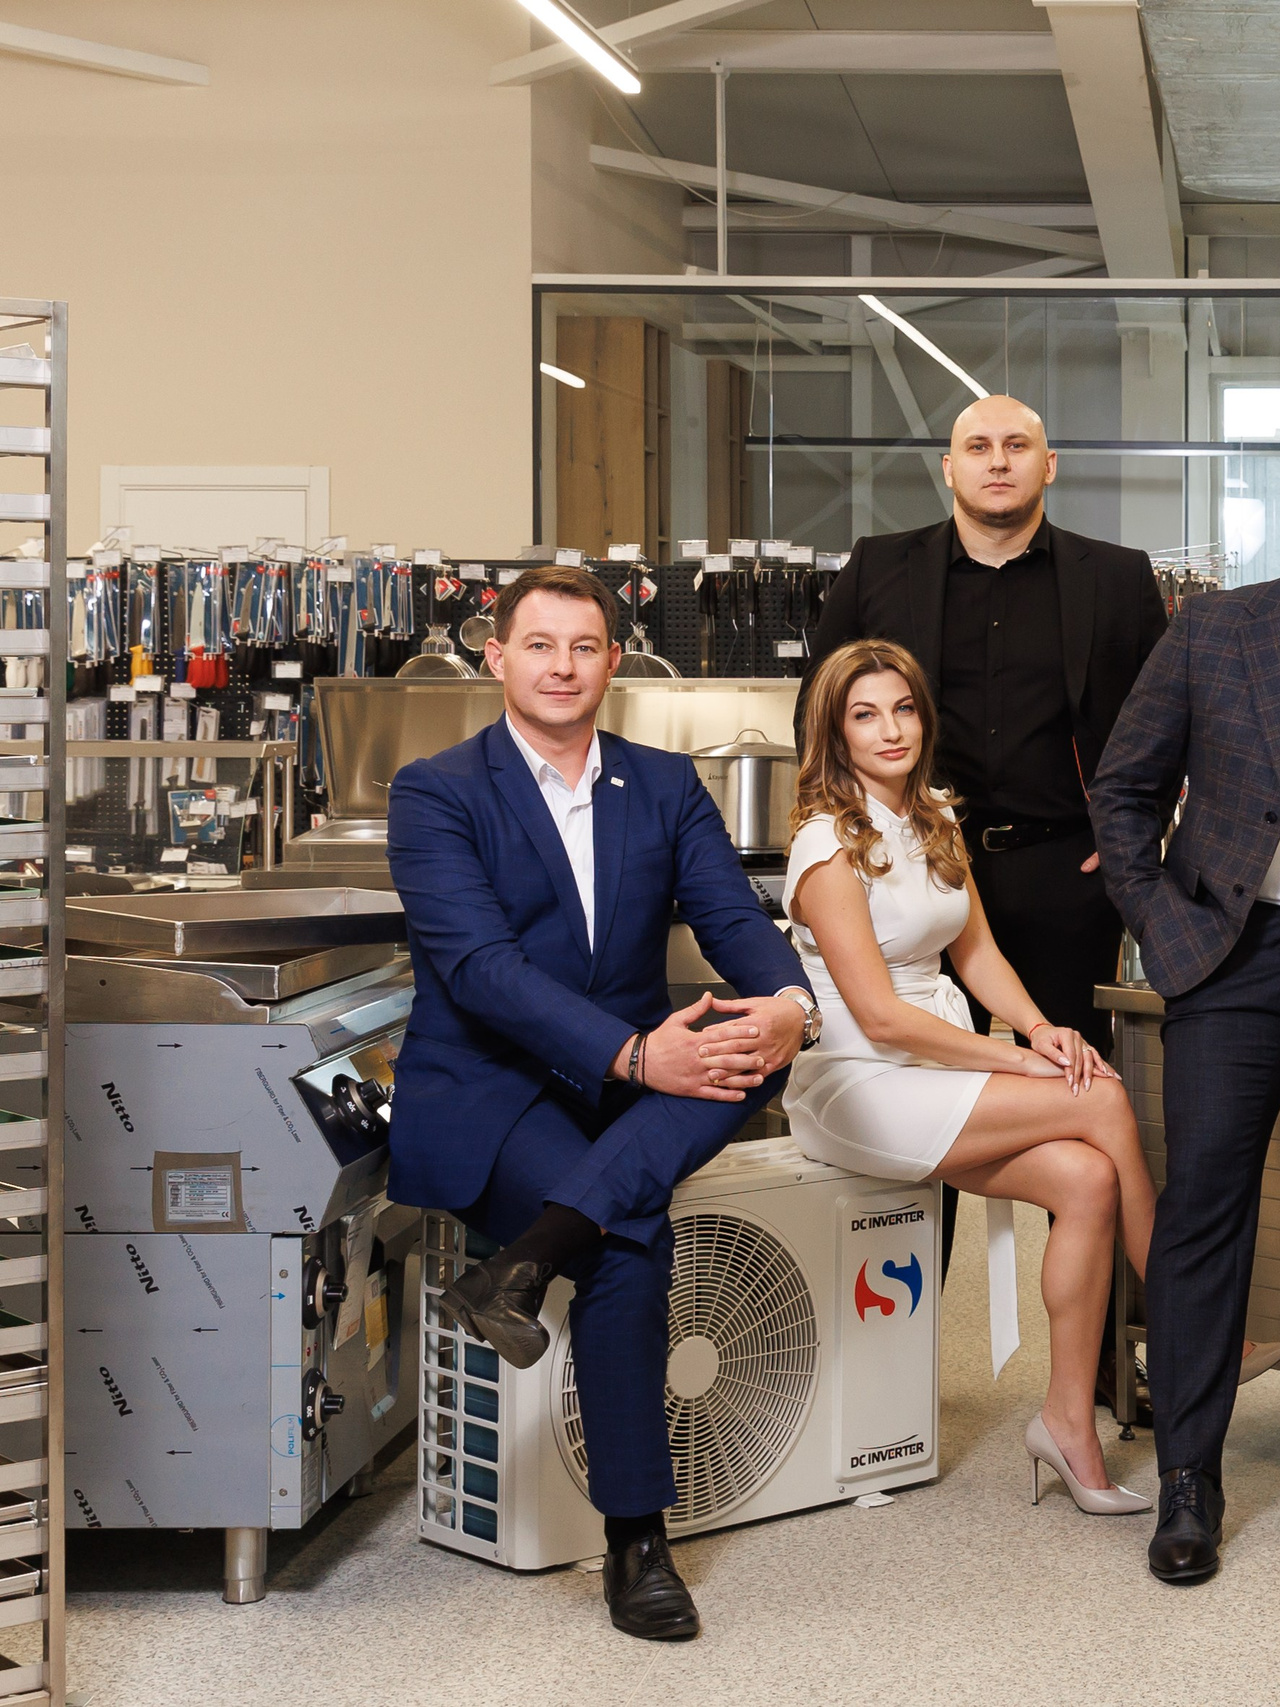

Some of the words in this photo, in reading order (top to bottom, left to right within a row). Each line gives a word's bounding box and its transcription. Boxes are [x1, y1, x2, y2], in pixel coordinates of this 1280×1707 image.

[752, 877, 776, 907] Nitto
[101, 1081, 134, 1133] Nitto
[277, 1105, 286, 1117] Fiber
[291, 1130, 301, 1143] Laser
[851, 1219, 867, 1231] DC
[869, 1210, 925, 1229] INVERTER
[126, 1243, 160, 1294] Nitto
[100, 1366, 133, 1417] Nitto
[851, 1454, 866, 1468] DC
[868, 1441, 925, 1464] INVERTER
